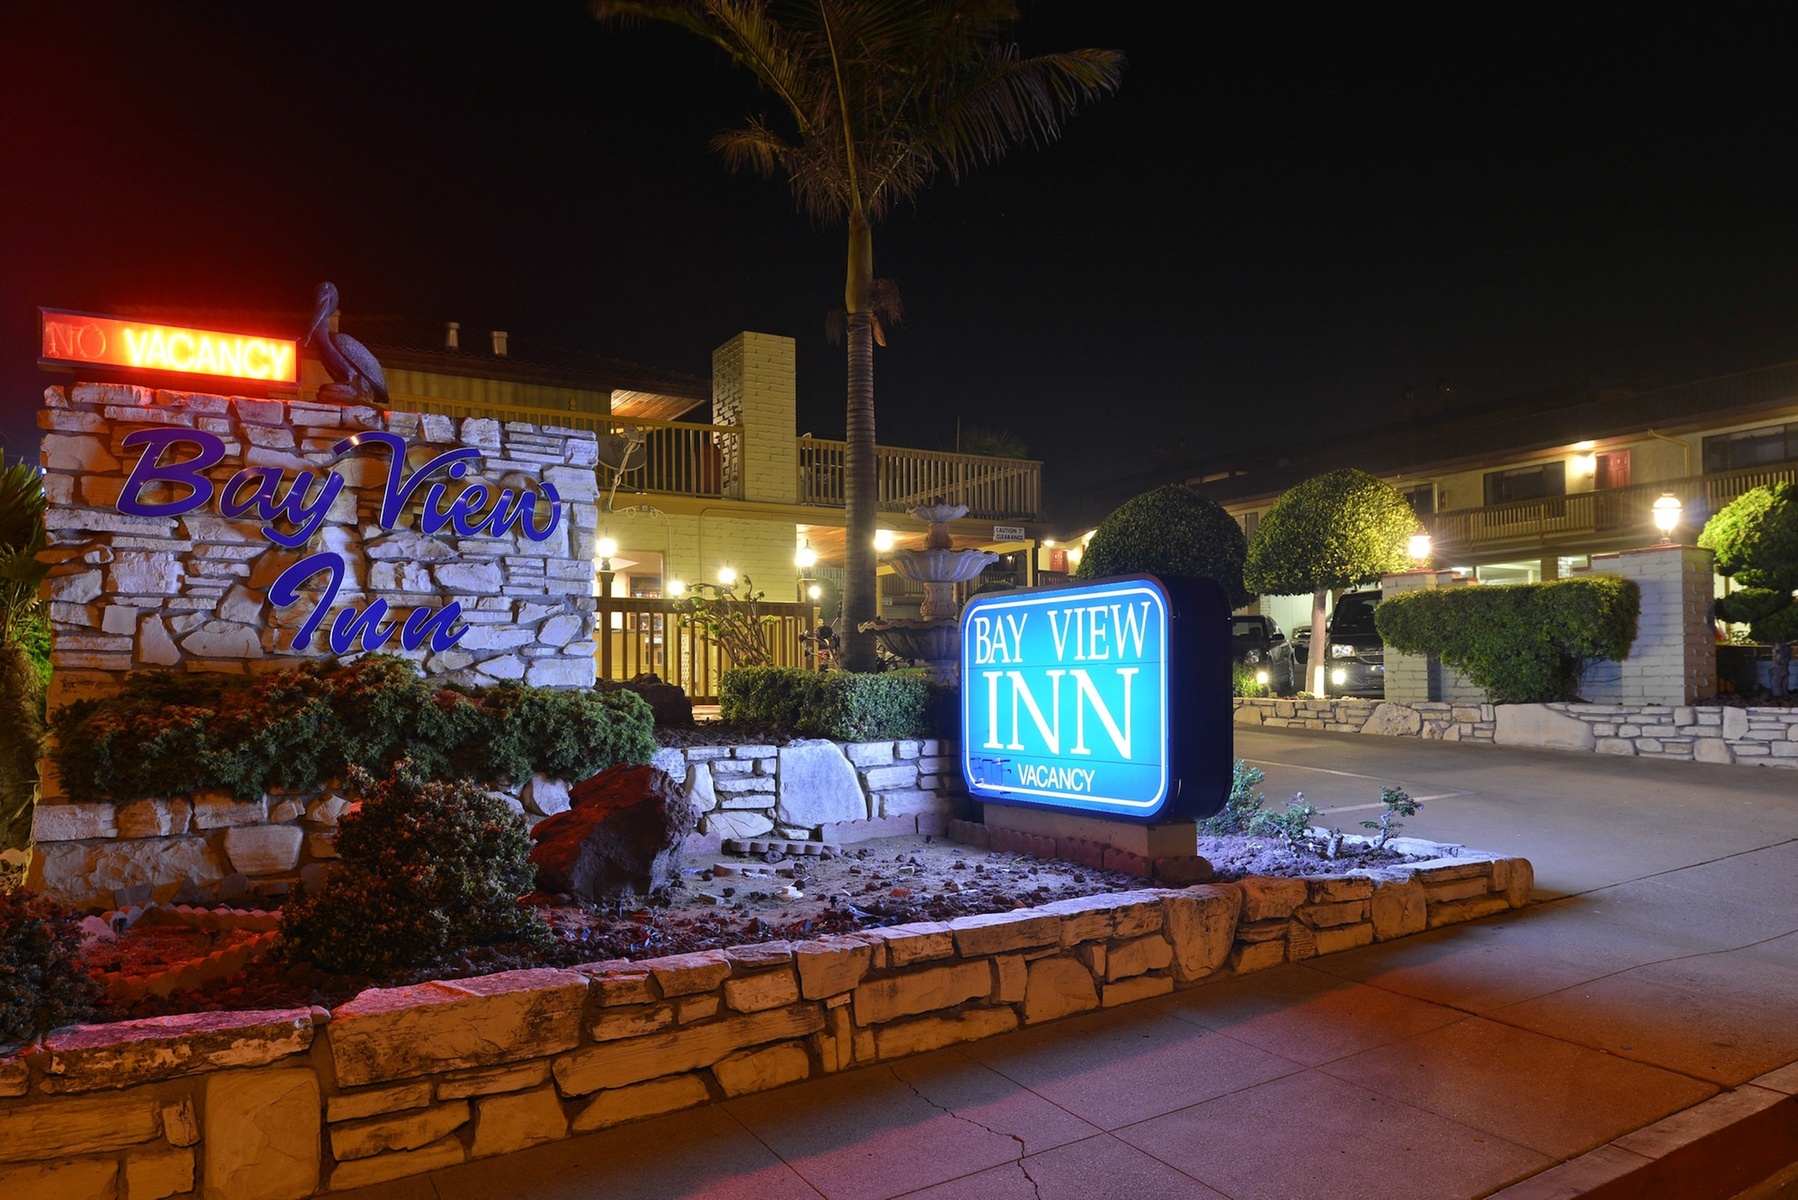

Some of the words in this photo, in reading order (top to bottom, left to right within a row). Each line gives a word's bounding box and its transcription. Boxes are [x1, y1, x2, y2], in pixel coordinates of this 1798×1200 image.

[48, 321, 107, 359] NO
[124, 328, 292, 381] VACANCY
[116, 428, 345, 548] Bay
[332, 430, 562, 542] View
[267, 552, 469, 655] Inn
[974, 612, 1028, 664] BAY
[1047, 601, 1151, 662] VIEW
[983, 667, 1139, 760] INN
[1017, 763, 1096, 793] VACANCY
